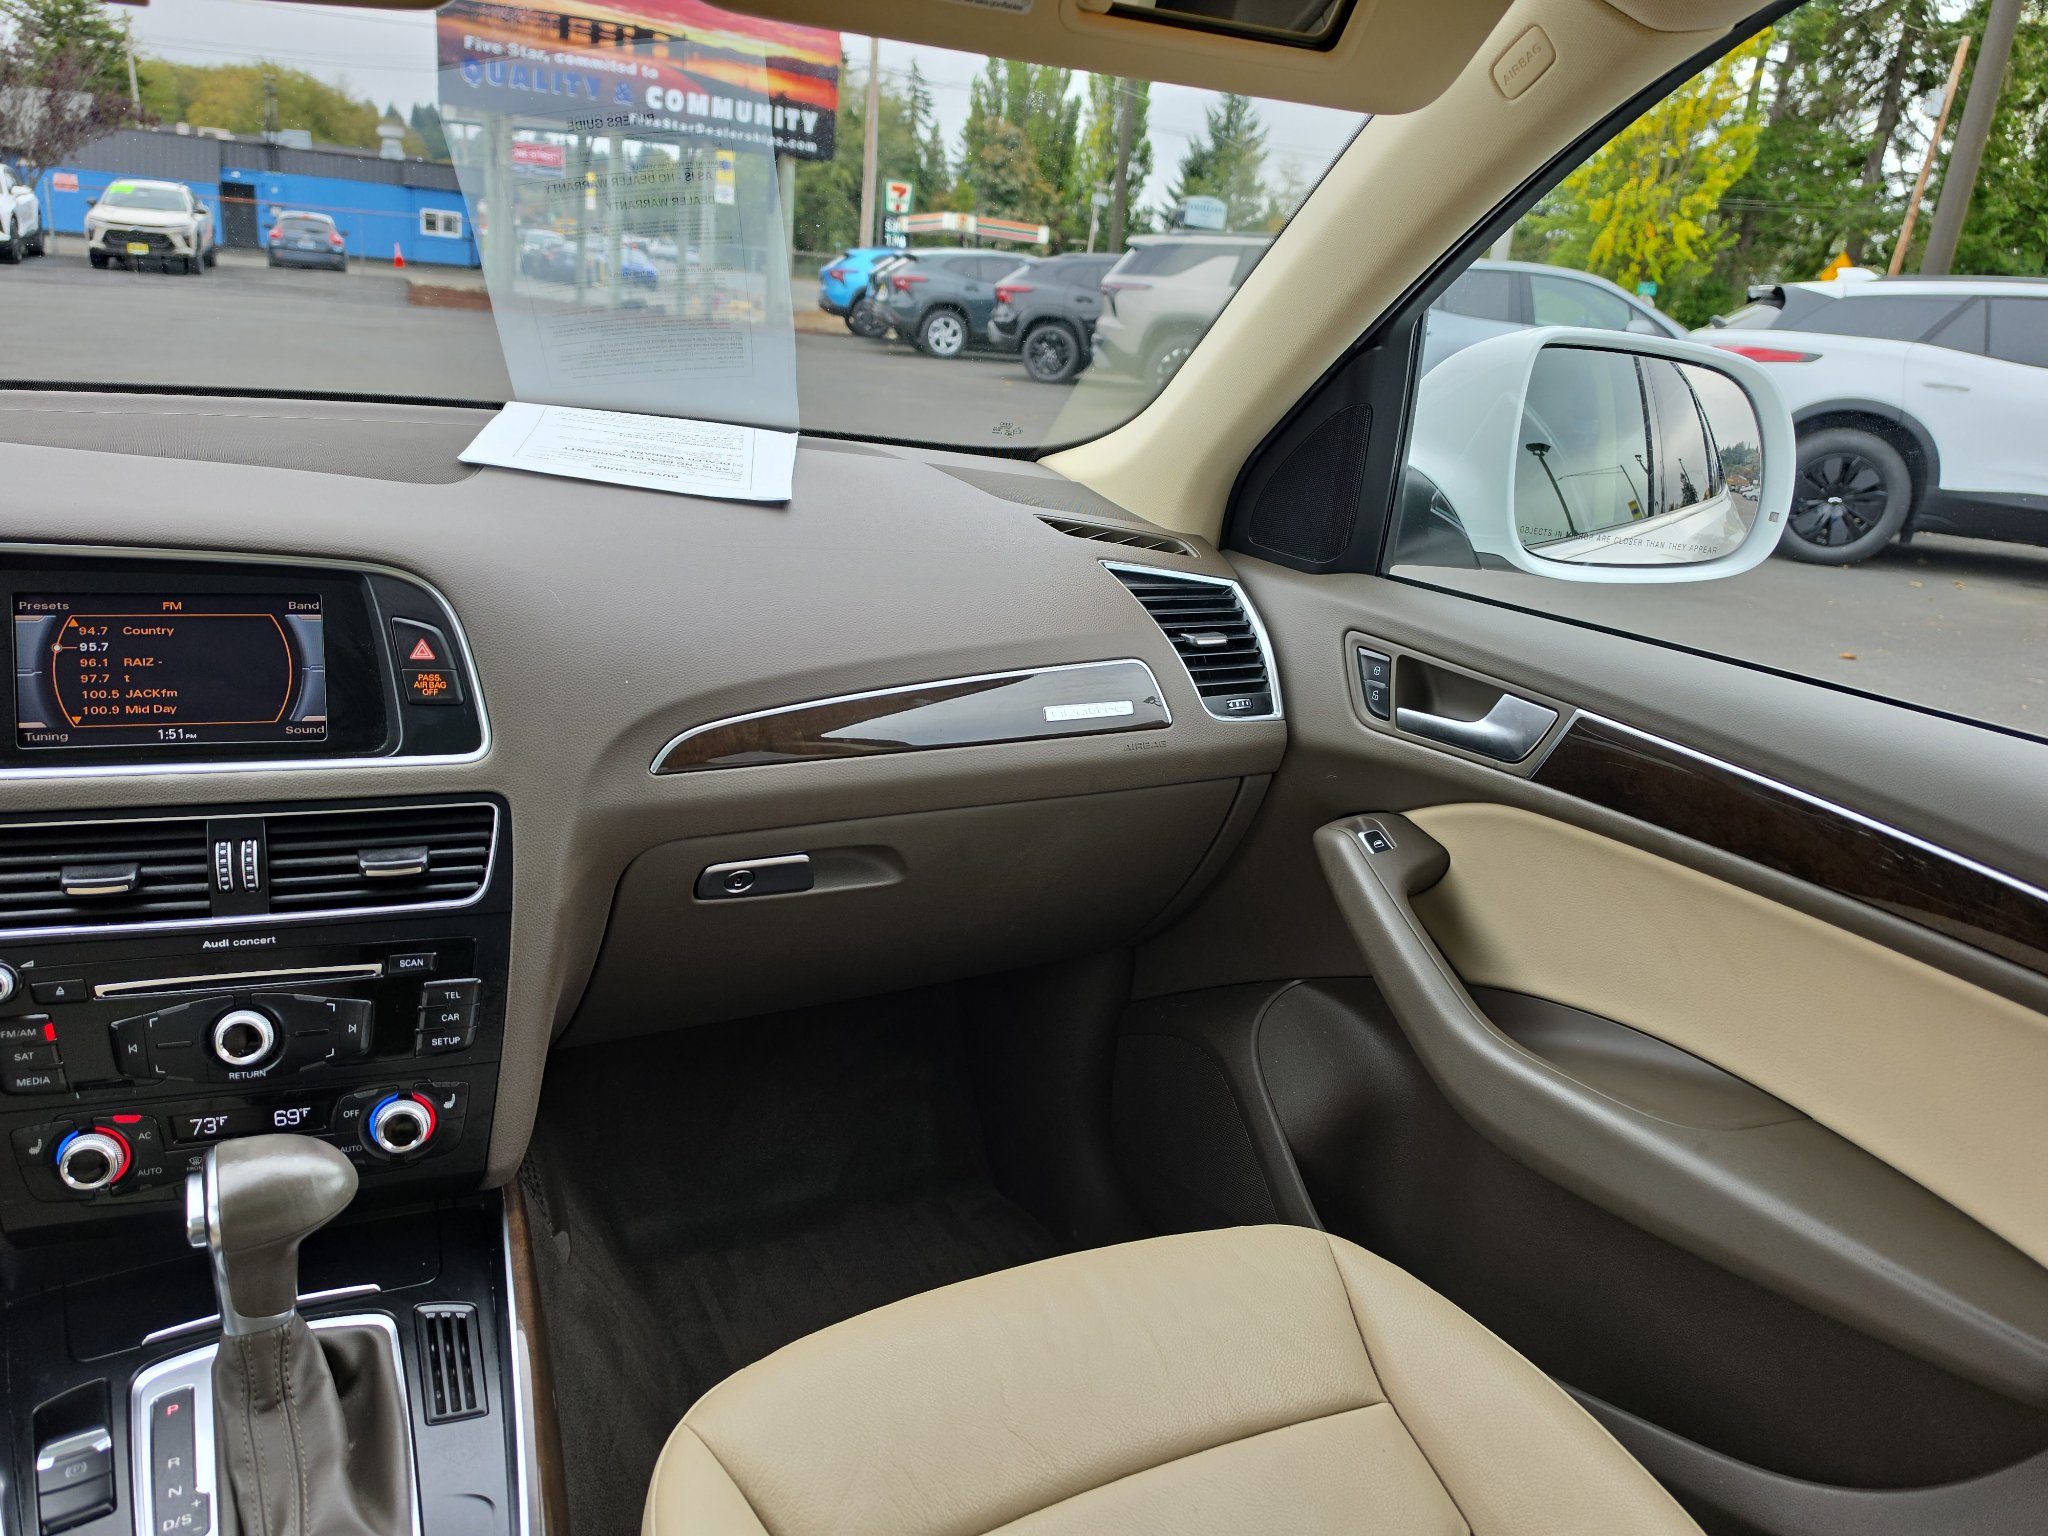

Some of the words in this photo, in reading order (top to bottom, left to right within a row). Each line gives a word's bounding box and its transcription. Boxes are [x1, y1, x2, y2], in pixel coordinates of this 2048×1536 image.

[463, 34, 503, 55] Five
[507, 41, 550, 65] Star,
[640, 63, 660, 80] to
[1503, 41, 1542, 86] AIRBAG
[459, 56, 602, 101] QUALITY
[645, 86, 819, 135] COMMUNITY
[1519, 526, 1553, 537] OBJECTS
[1596, 535, 1611, 543] ARE
[1614, 536, 1643, 547] CLOSER
[1646, 540, 1665, 549] THAN
[1668, 543, 1687, 551] THEY
[1688, 545, 1718, 555] APPEAR
[19, 602, 69, 610] Presets
[163, 602, 181, 610] FM
[79, 627, 107, 635] 94.7
[123, 627, 175, 637] Country
[80, 642, 108, 651] 95.7
[80, 658, 107, 667] 96.1
[124, 658, 154, 666] RAIZ
[81, 674, 109, 683] 97.7
[418, 673, 442, 682] PASS.
[82, 690, 119, 699] 100.5
[126, 689, 177, 698] JACKfm
[422, 688, 439, 696] OFF
[83, 706, 119, 715] 100.9
[126, 705, 149, 713] Mid
[154, 705, 176, 714] Day
[158, 729, 183, 740] 1:51
[286, 726, 324, 734] Sound
[25, 733, 68, 742] Tuning
[203, 939, 229, 948] Audi
[233, 936, 276, 946] concert
[400, 959, 423, 967] SCAN
[442, 1013, 459, 1021] CAR
[0, 1028, 36, 1038] FM/AM
[432, 1037, 460, 1046] SETUP
[14, 1052, 34, 1061] SAT
[228, 1069, 267, 1080] RETURN
[17, 1076, 50, 1087] MEDIA
[343, 1110, 359, 1118] OFF
[138, 1132, 151, 1140] AC
[340, 1144, 363, 1153] AUTO
[138, 1167, 162, 1176] AUTO
[166, 1404, 179, 1416] P
[168, 1457, 181, 1470] R
[168, 1485, 183, 1499] N
[162, 1514, 192, 1532] D/S
